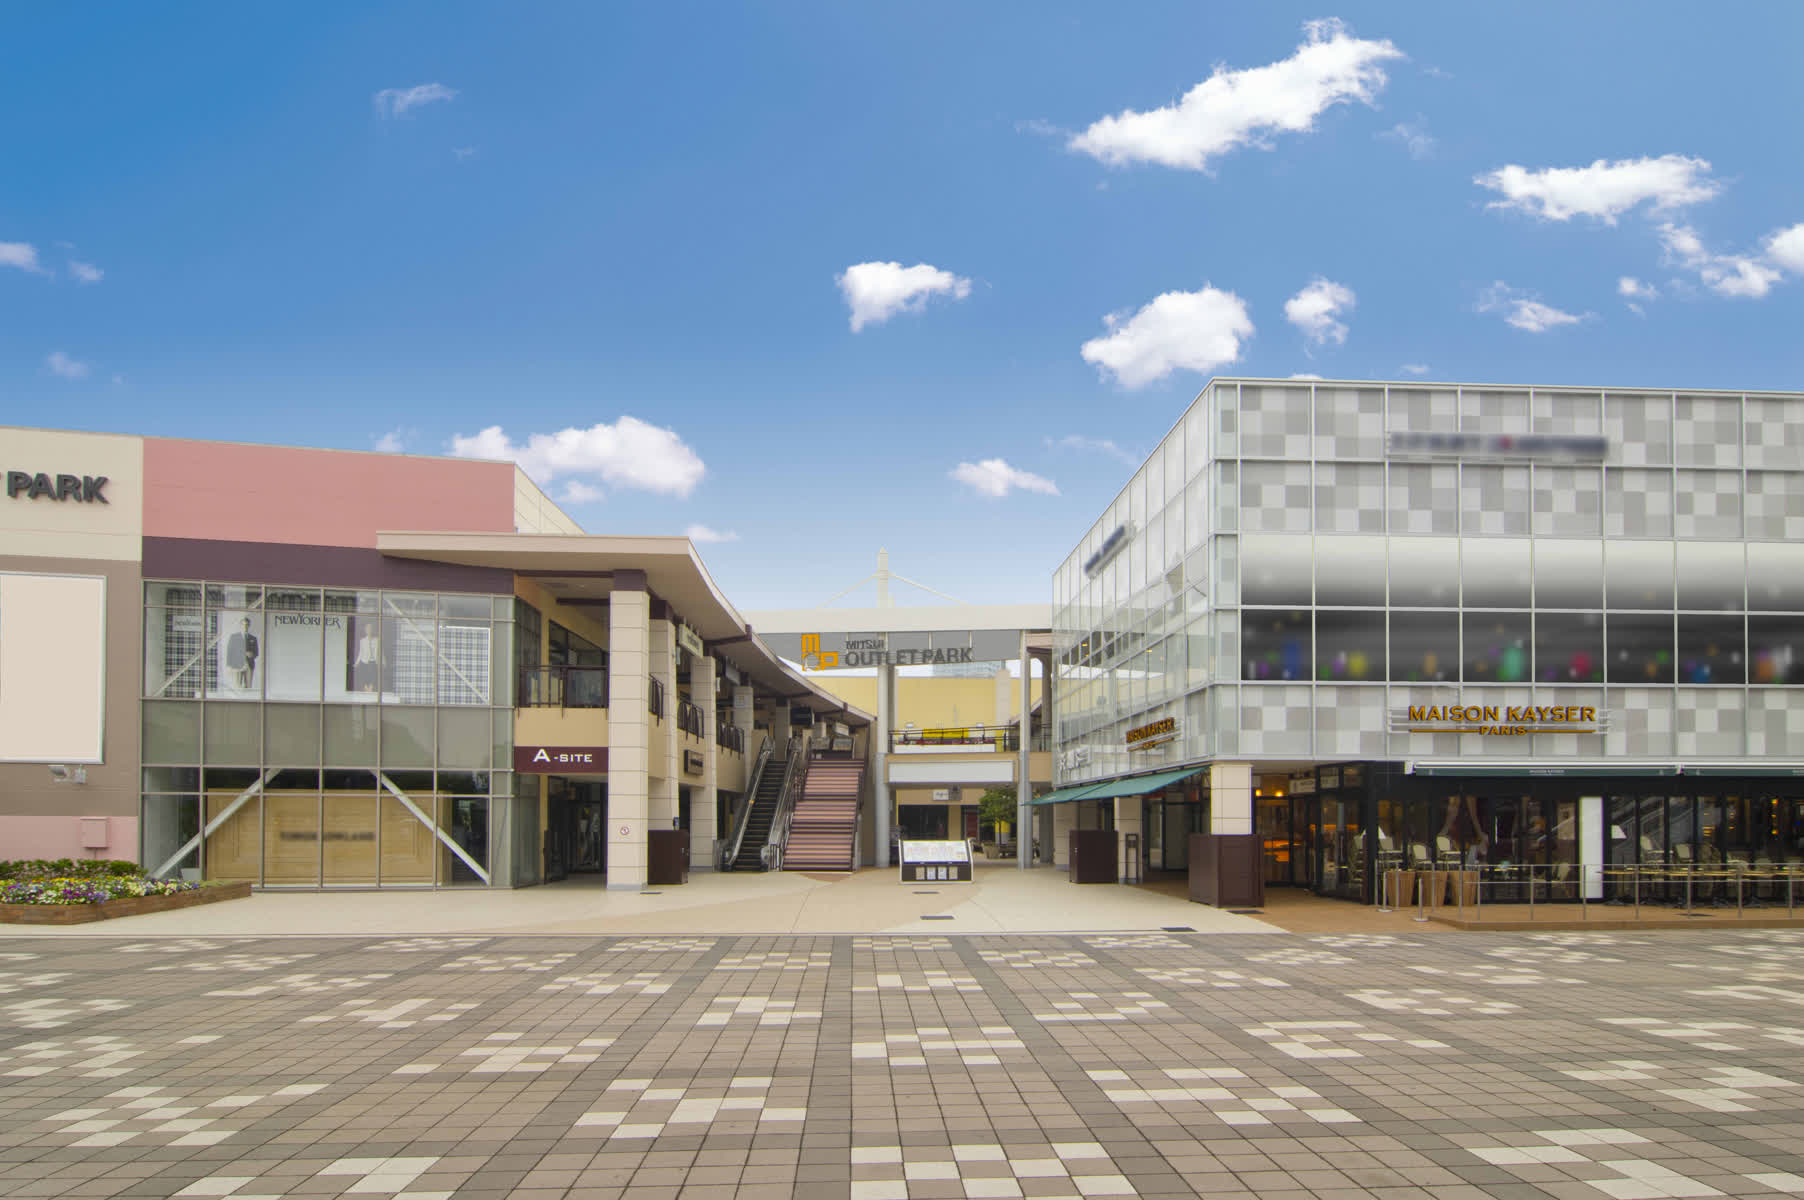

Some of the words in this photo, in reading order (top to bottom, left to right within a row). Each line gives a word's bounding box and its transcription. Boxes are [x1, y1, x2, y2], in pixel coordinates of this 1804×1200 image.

[7, 471, 110, 504] PARK
[274, 614, 341, 628] NEWYORER
[846, 639, 885, 650] MITSUI
[845, 650, 918, 667] OUTLET
[922, 648, 974, 664] PARK
[1409, 706, 1500, 722] MAISON
[1507, 706, 1597, 722] KAYSER
[1479, 726, 1527, 736] PARIS
